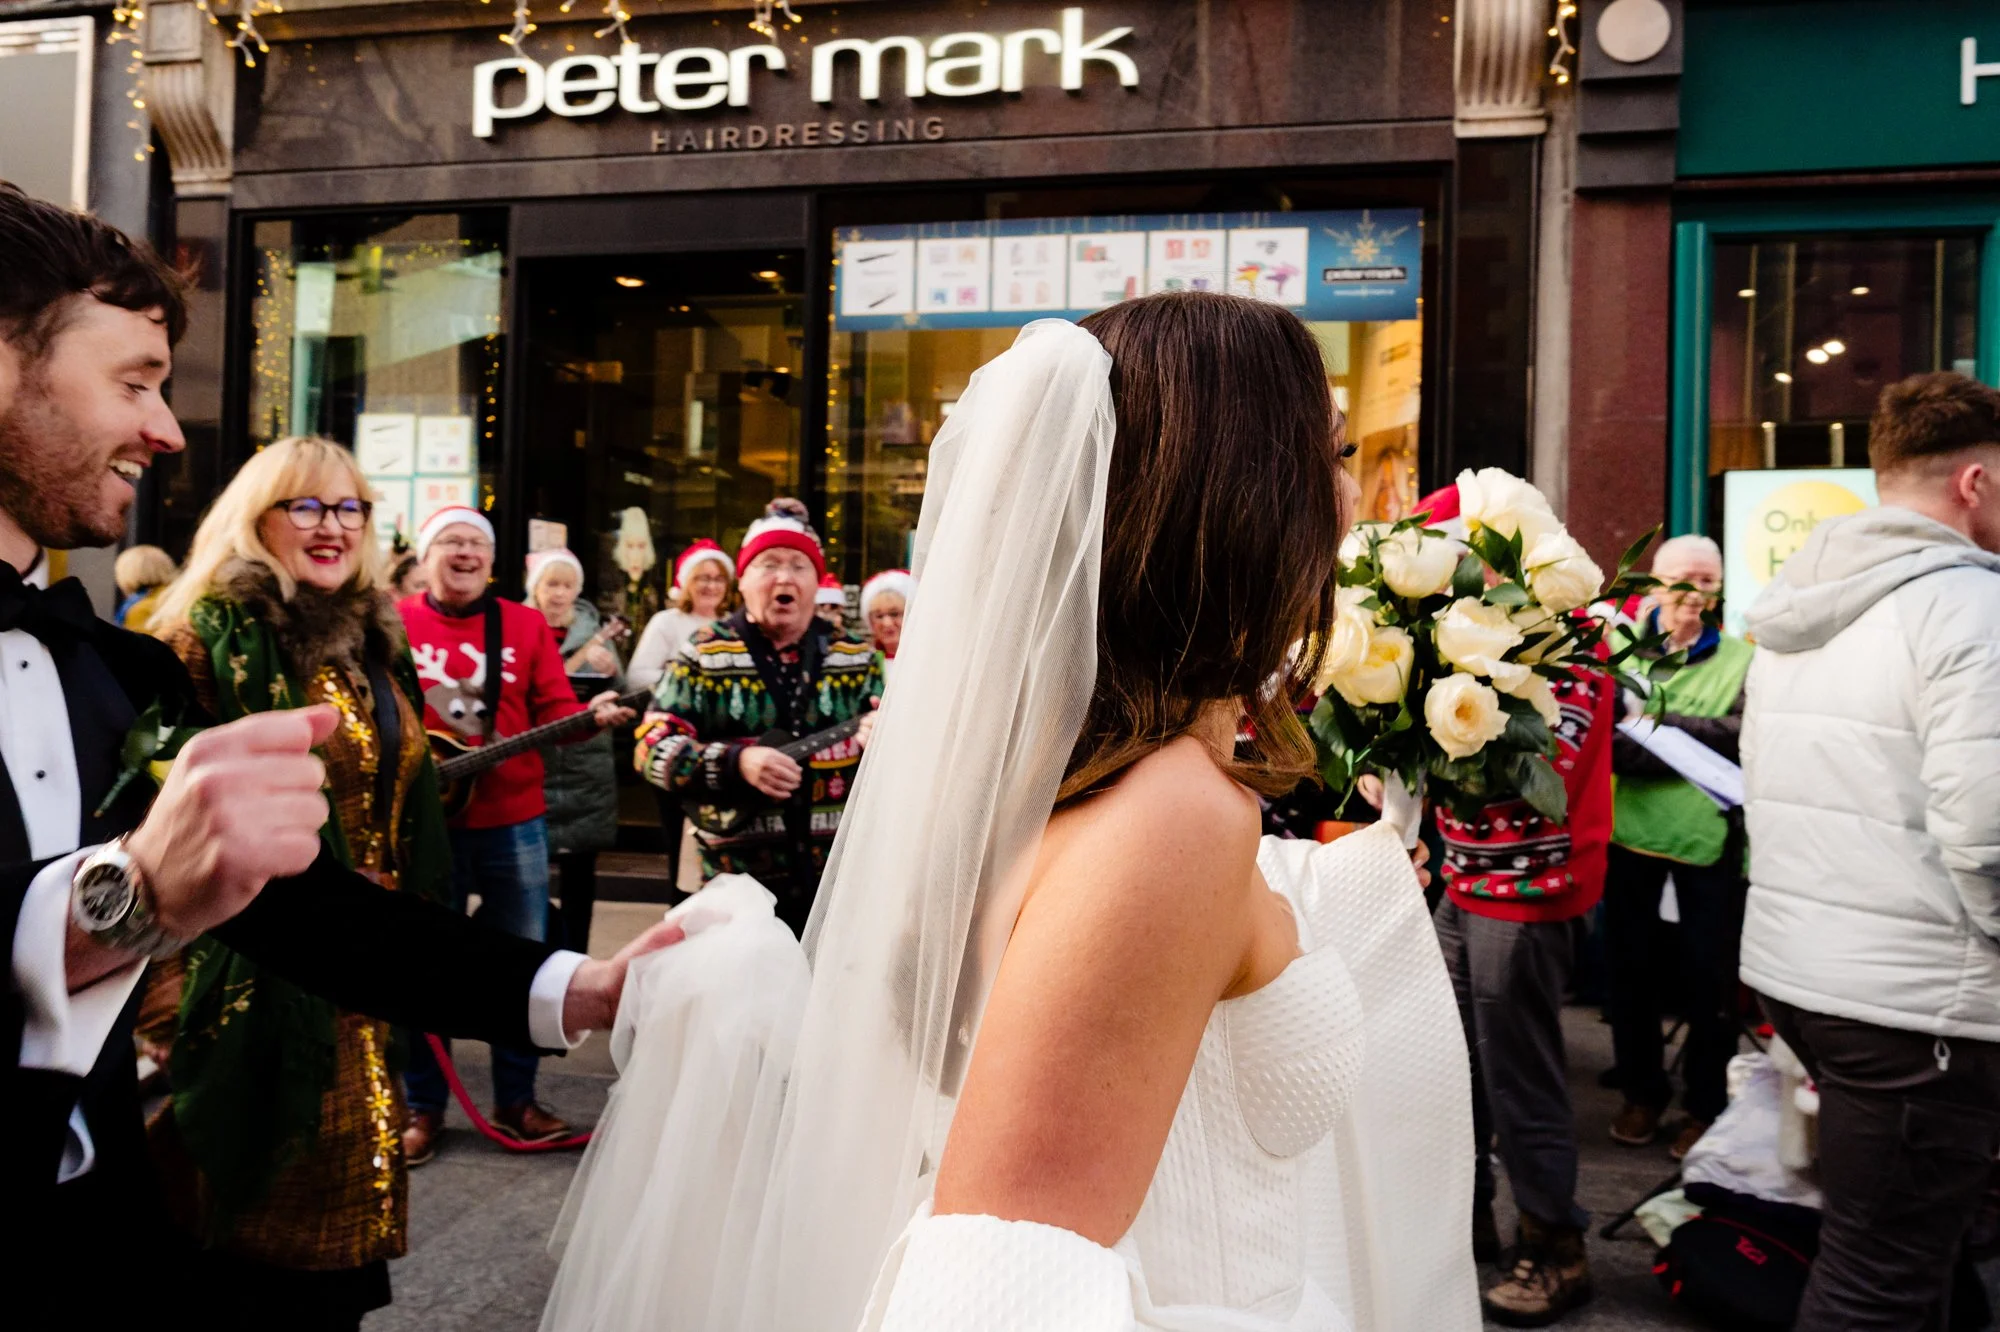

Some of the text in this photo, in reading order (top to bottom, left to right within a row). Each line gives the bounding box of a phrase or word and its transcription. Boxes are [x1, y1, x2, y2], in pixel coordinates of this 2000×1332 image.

[472, 7, 1139, 138] peter mark
[650, 116, 946, 151] HAIRDRESSING
[1764, 509, 1820, 533] Onl
